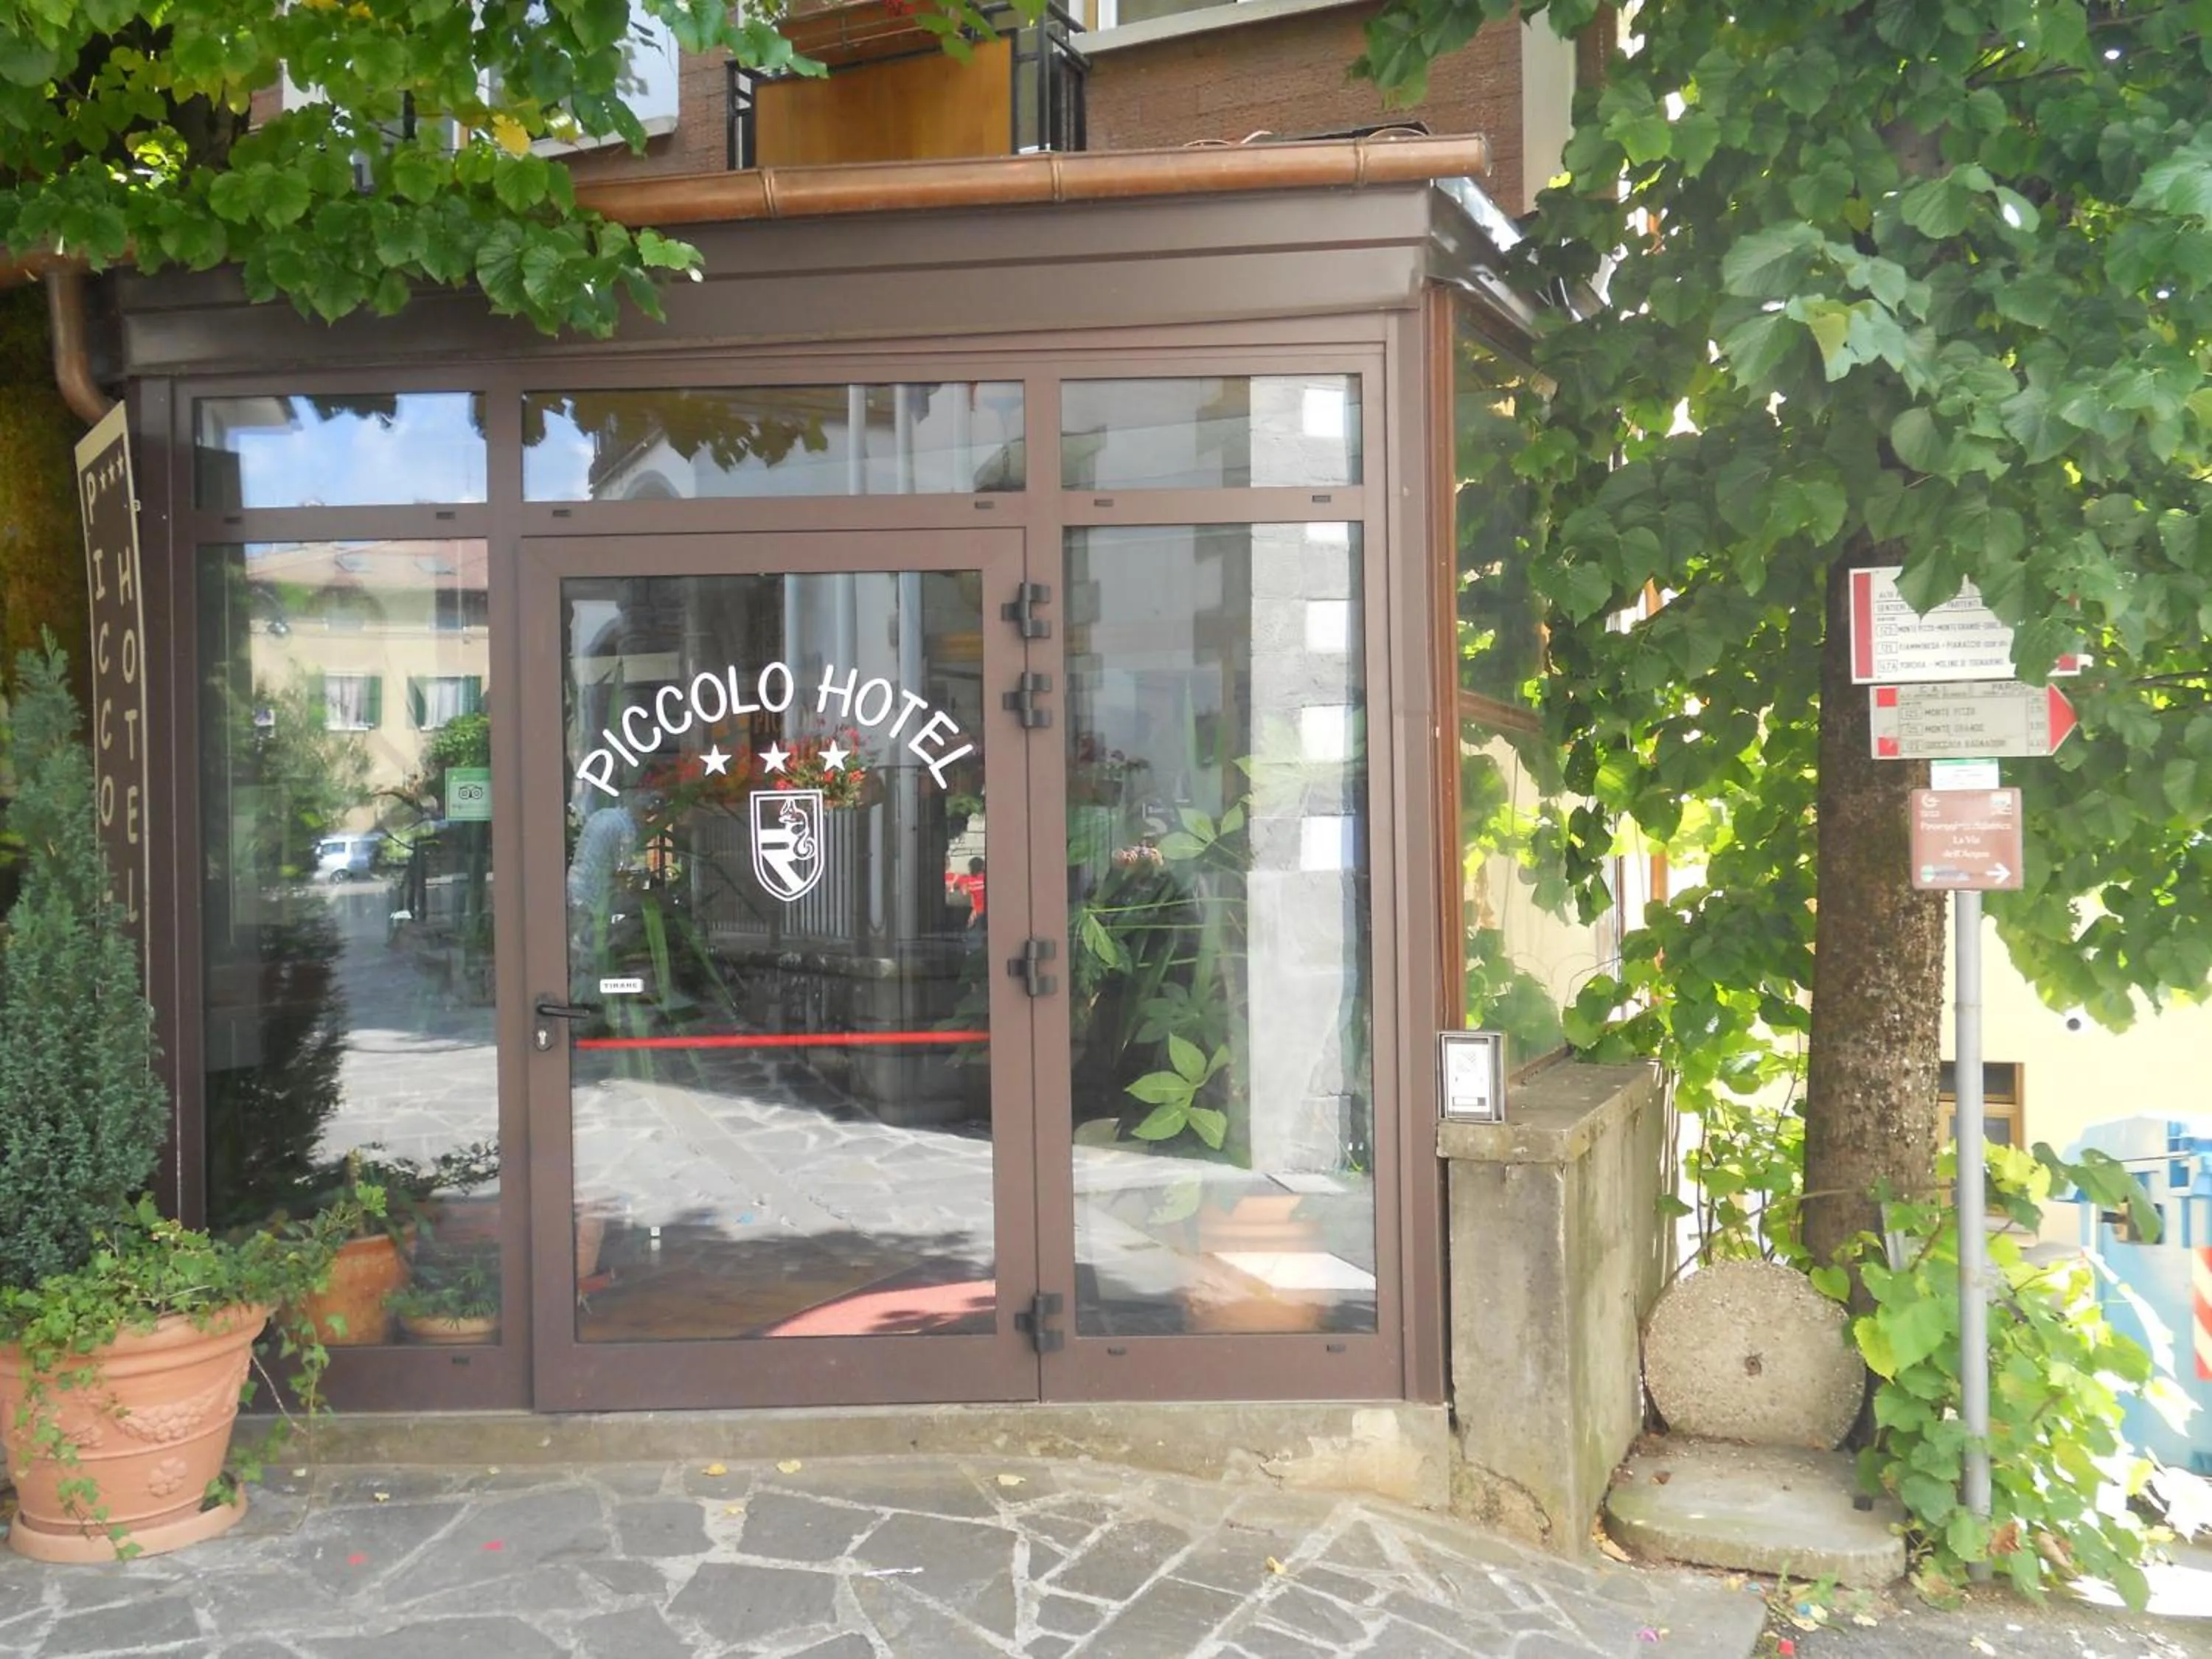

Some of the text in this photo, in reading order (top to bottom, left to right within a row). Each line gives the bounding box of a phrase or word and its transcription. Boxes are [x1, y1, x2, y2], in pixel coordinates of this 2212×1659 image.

[86, 470, 114, 904] PICCOL
[117, 546, 139, 923] HOTEL
[577, 661, 973, 797] PICCOLO HOTEL
